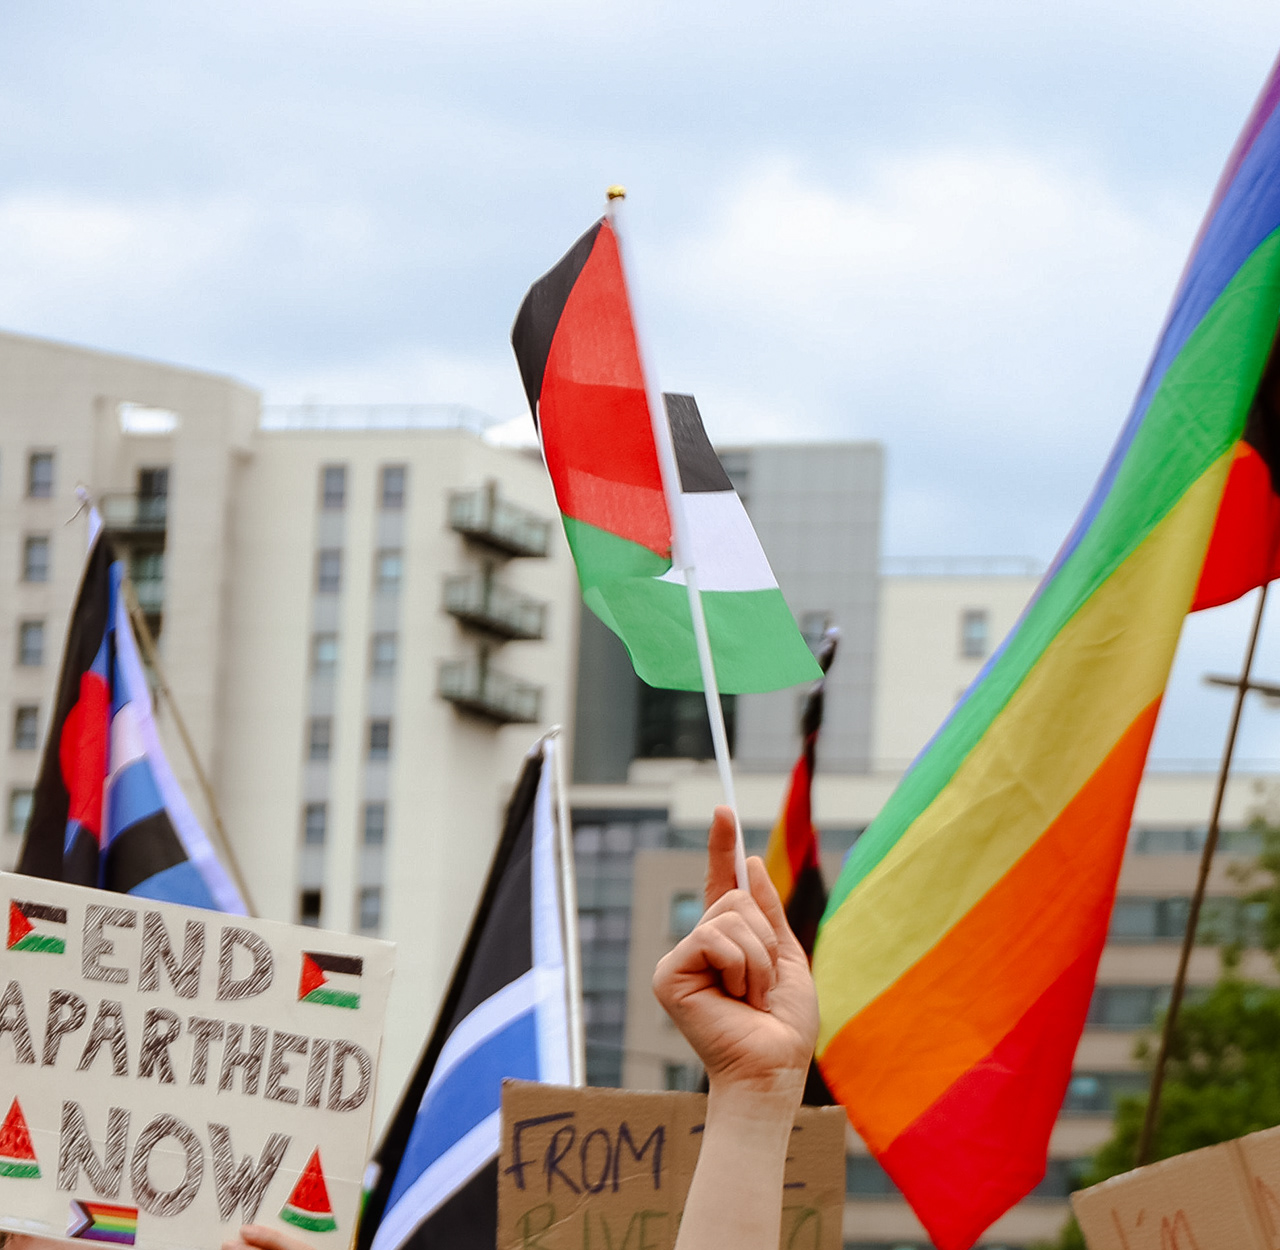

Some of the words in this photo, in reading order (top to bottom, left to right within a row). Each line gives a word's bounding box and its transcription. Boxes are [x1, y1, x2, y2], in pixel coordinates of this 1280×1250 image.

[82, 904, 274, 1000] END
[0, 980, 372, 1112] APARTHEID
[57, 1100, 292, 1225] NOW
[504, 1111, 666, 1195] FROM
